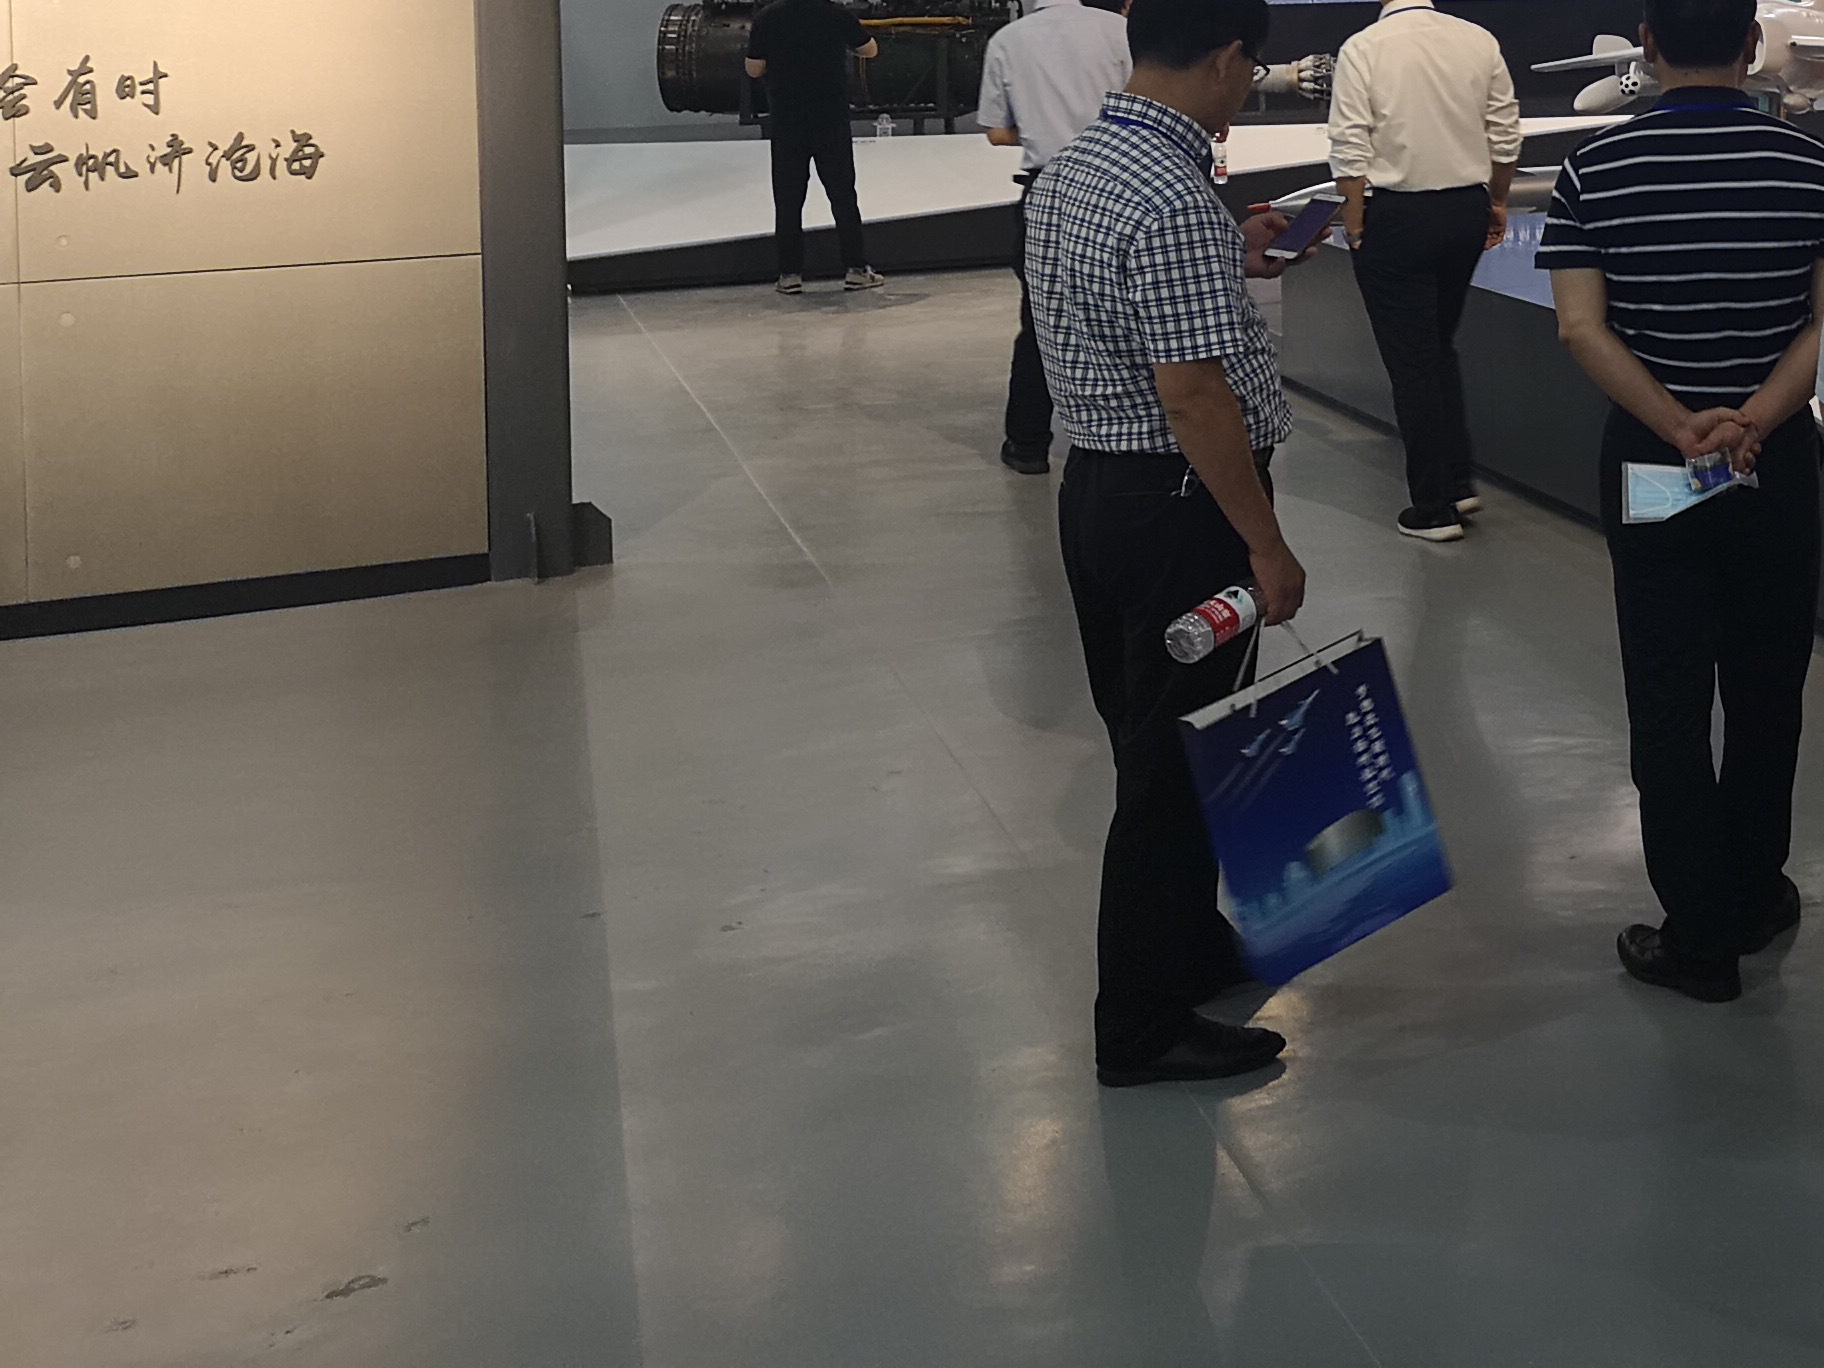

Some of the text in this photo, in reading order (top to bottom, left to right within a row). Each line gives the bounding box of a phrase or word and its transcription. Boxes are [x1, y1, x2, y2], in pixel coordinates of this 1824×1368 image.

[9, 129, 325, 194] 云帆济沧海
